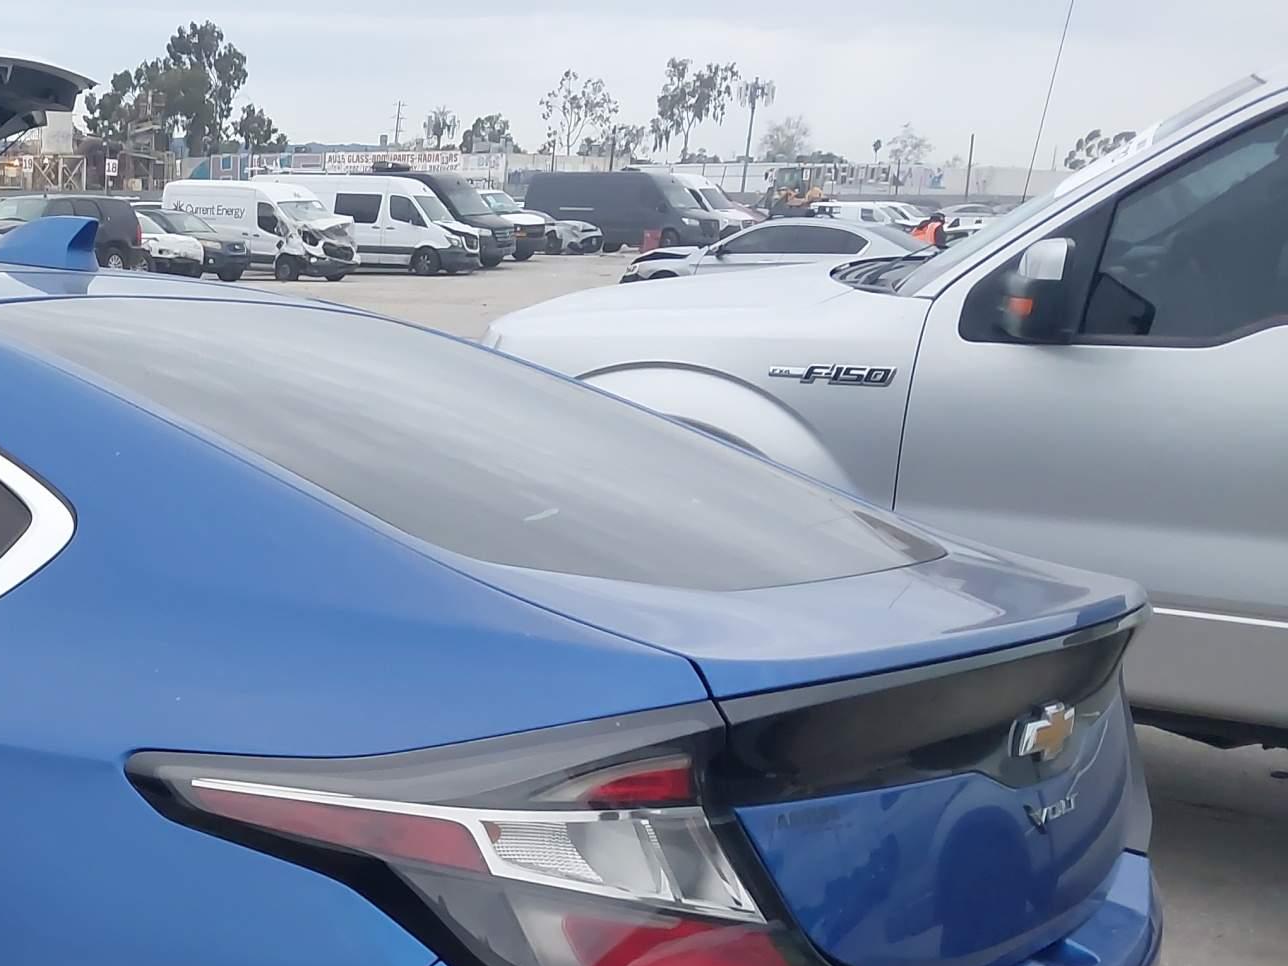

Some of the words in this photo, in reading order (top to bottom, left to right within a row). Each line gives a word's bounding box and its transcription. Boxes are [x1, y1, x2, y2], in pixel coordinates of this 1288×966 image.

[23, 158, 33, 169] 19
[106, 162, 117, 173] 18
[185, 204, 215, 216] Current
[216, 205, 246, 219] Energy
[801, 364, 896, 386] F-150
[1025, 792, 1079, 826] VOLT
